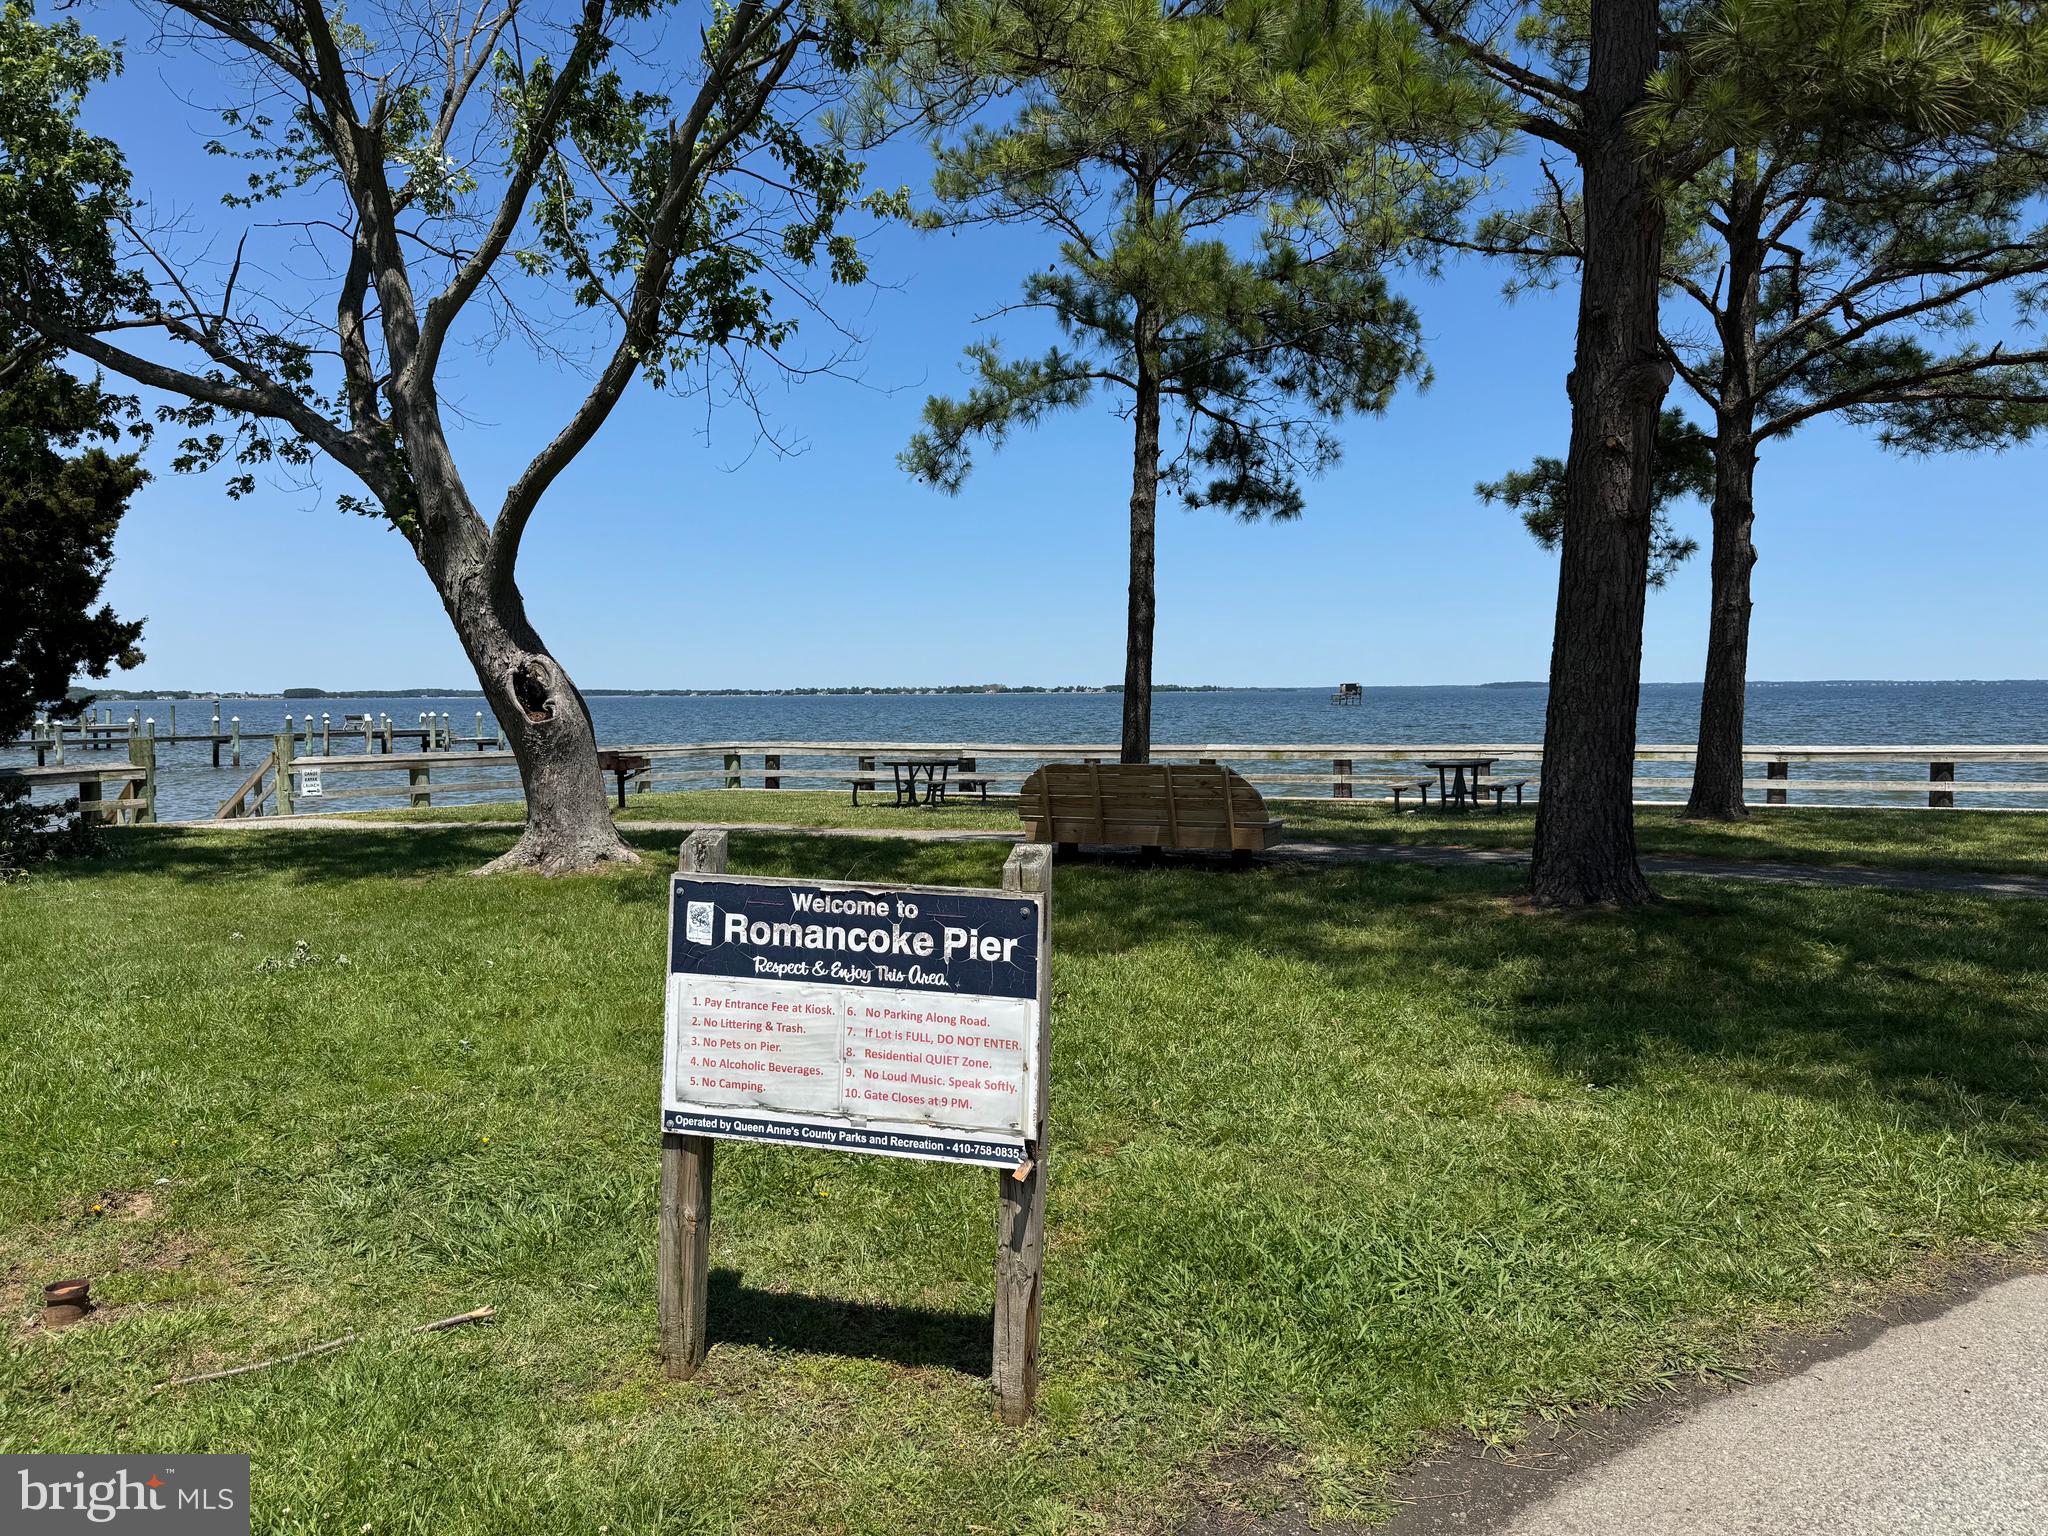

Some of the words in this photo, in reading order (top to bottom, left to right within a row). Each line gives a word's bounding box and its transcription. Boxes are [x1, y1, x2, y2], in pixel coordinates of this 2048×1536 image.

[793, 893, 889, 915] Welcome
[896, 900, 918, 919] to
[724, 914, 934, 956] Romancoke
[944, 928, 1017, 963] Pier
[753, 956, 808, 977] Respect
[812, 961, 828, 976] &
[831, 962, 872, 983] Enjoy
[877, 965, 906, 981] This
[908, 966, 948, 985] Area.
[693, 997, 702, 1006] 1.
[705, 998, 722, 1009] Pay
[725, 999, 768, 1010] Entrance
[772, 1002, 789, 1012] Fee
[792, 1004, 802, 1012] at
[806, 1004, 835, 1015] Kiosk.
[847, 1007, 856, 1016] 6.
[866, 1008, 880, 1017] No
[884, 1009, 922, 1023] Parking
[926, 1013, 956, 1026] Along
[960, 1015, 990, 1026] Road.
[692, 1017, 700, 1026] 2.
[704, 1018, 717, 1027] No
[721, 1019, 762, 1032] Littering
[765, 1021, 773, 1031] &
[777, 1023, 805, 1033] Trash.
[692, 1037, 700, 1045] 3.
[704, 1038, 717, 1047] No
[720, 1039, 741, 1049] Pets
[761, 1042, 781, 1051] Pier.
[847, 1027, 856, 1036] 7.
[866, 1028, 873, 1037] If
[876, 1029, 891, 1039] Lot
[895, 1031, 903, 1041] is
[906, 1032, 933, 1044] FULL,
[938, 1034, 953, 1044] DO
[957, 1036, 981, 1046] NOT
[984, 1038, 1021, 1051] ENTER.
[691, 1057, 699, 1066] 4.
[703, 1058, 716, 1067] No
[719, 1059, 765, 1071] Alcoholic
[769, 1062, 823, 1076] Beverages.
[846, 1047, 855, 1056] 8.
[865, 1049, 922, 1063] Residential
[926, 1054, 959, 1065] QUIET
[962, 1057, 991, 1068] Zone.
[690, 1077, 699, 1085] 5.
[702, 1077, 716, 1087] No
[719, 1079, 766, 1093] Camping.
[846, 1068, 854, 1077] 9.
[865, 1069, 879, 1079] No
[882, 1072, 907, 1082] Loud
[911, 1074, 944, 1085] Music.
[949, 1077, 980, 1088] Speak
[985, 1080, 1017, 1094] Softly.
[846, 1088, 860, 1098] 10.
[864, 1090, 888, 1101] Gate
[892, 1093, 925, 1104] Closes
[928, 1097, 938, 1106] at
[941, 1097, 949, 1107] 9
[951, 1098, 972, 1109] PM.
[676, 1115, 717, 1129] Operated
[720, 1120, 731, 1131] by
[734, 1121, 764, 1132] Queen
[766, 1124, 799, 1136] Anne's
[802, 1128, 836, 1142] County
[839, 1131, 867, 1143] Parks
[869, 1134, 888, 1146] and
[891, 1136, 943, 1150] Recreation
[952, 1143, 1020, 1159] 410-758-0835
